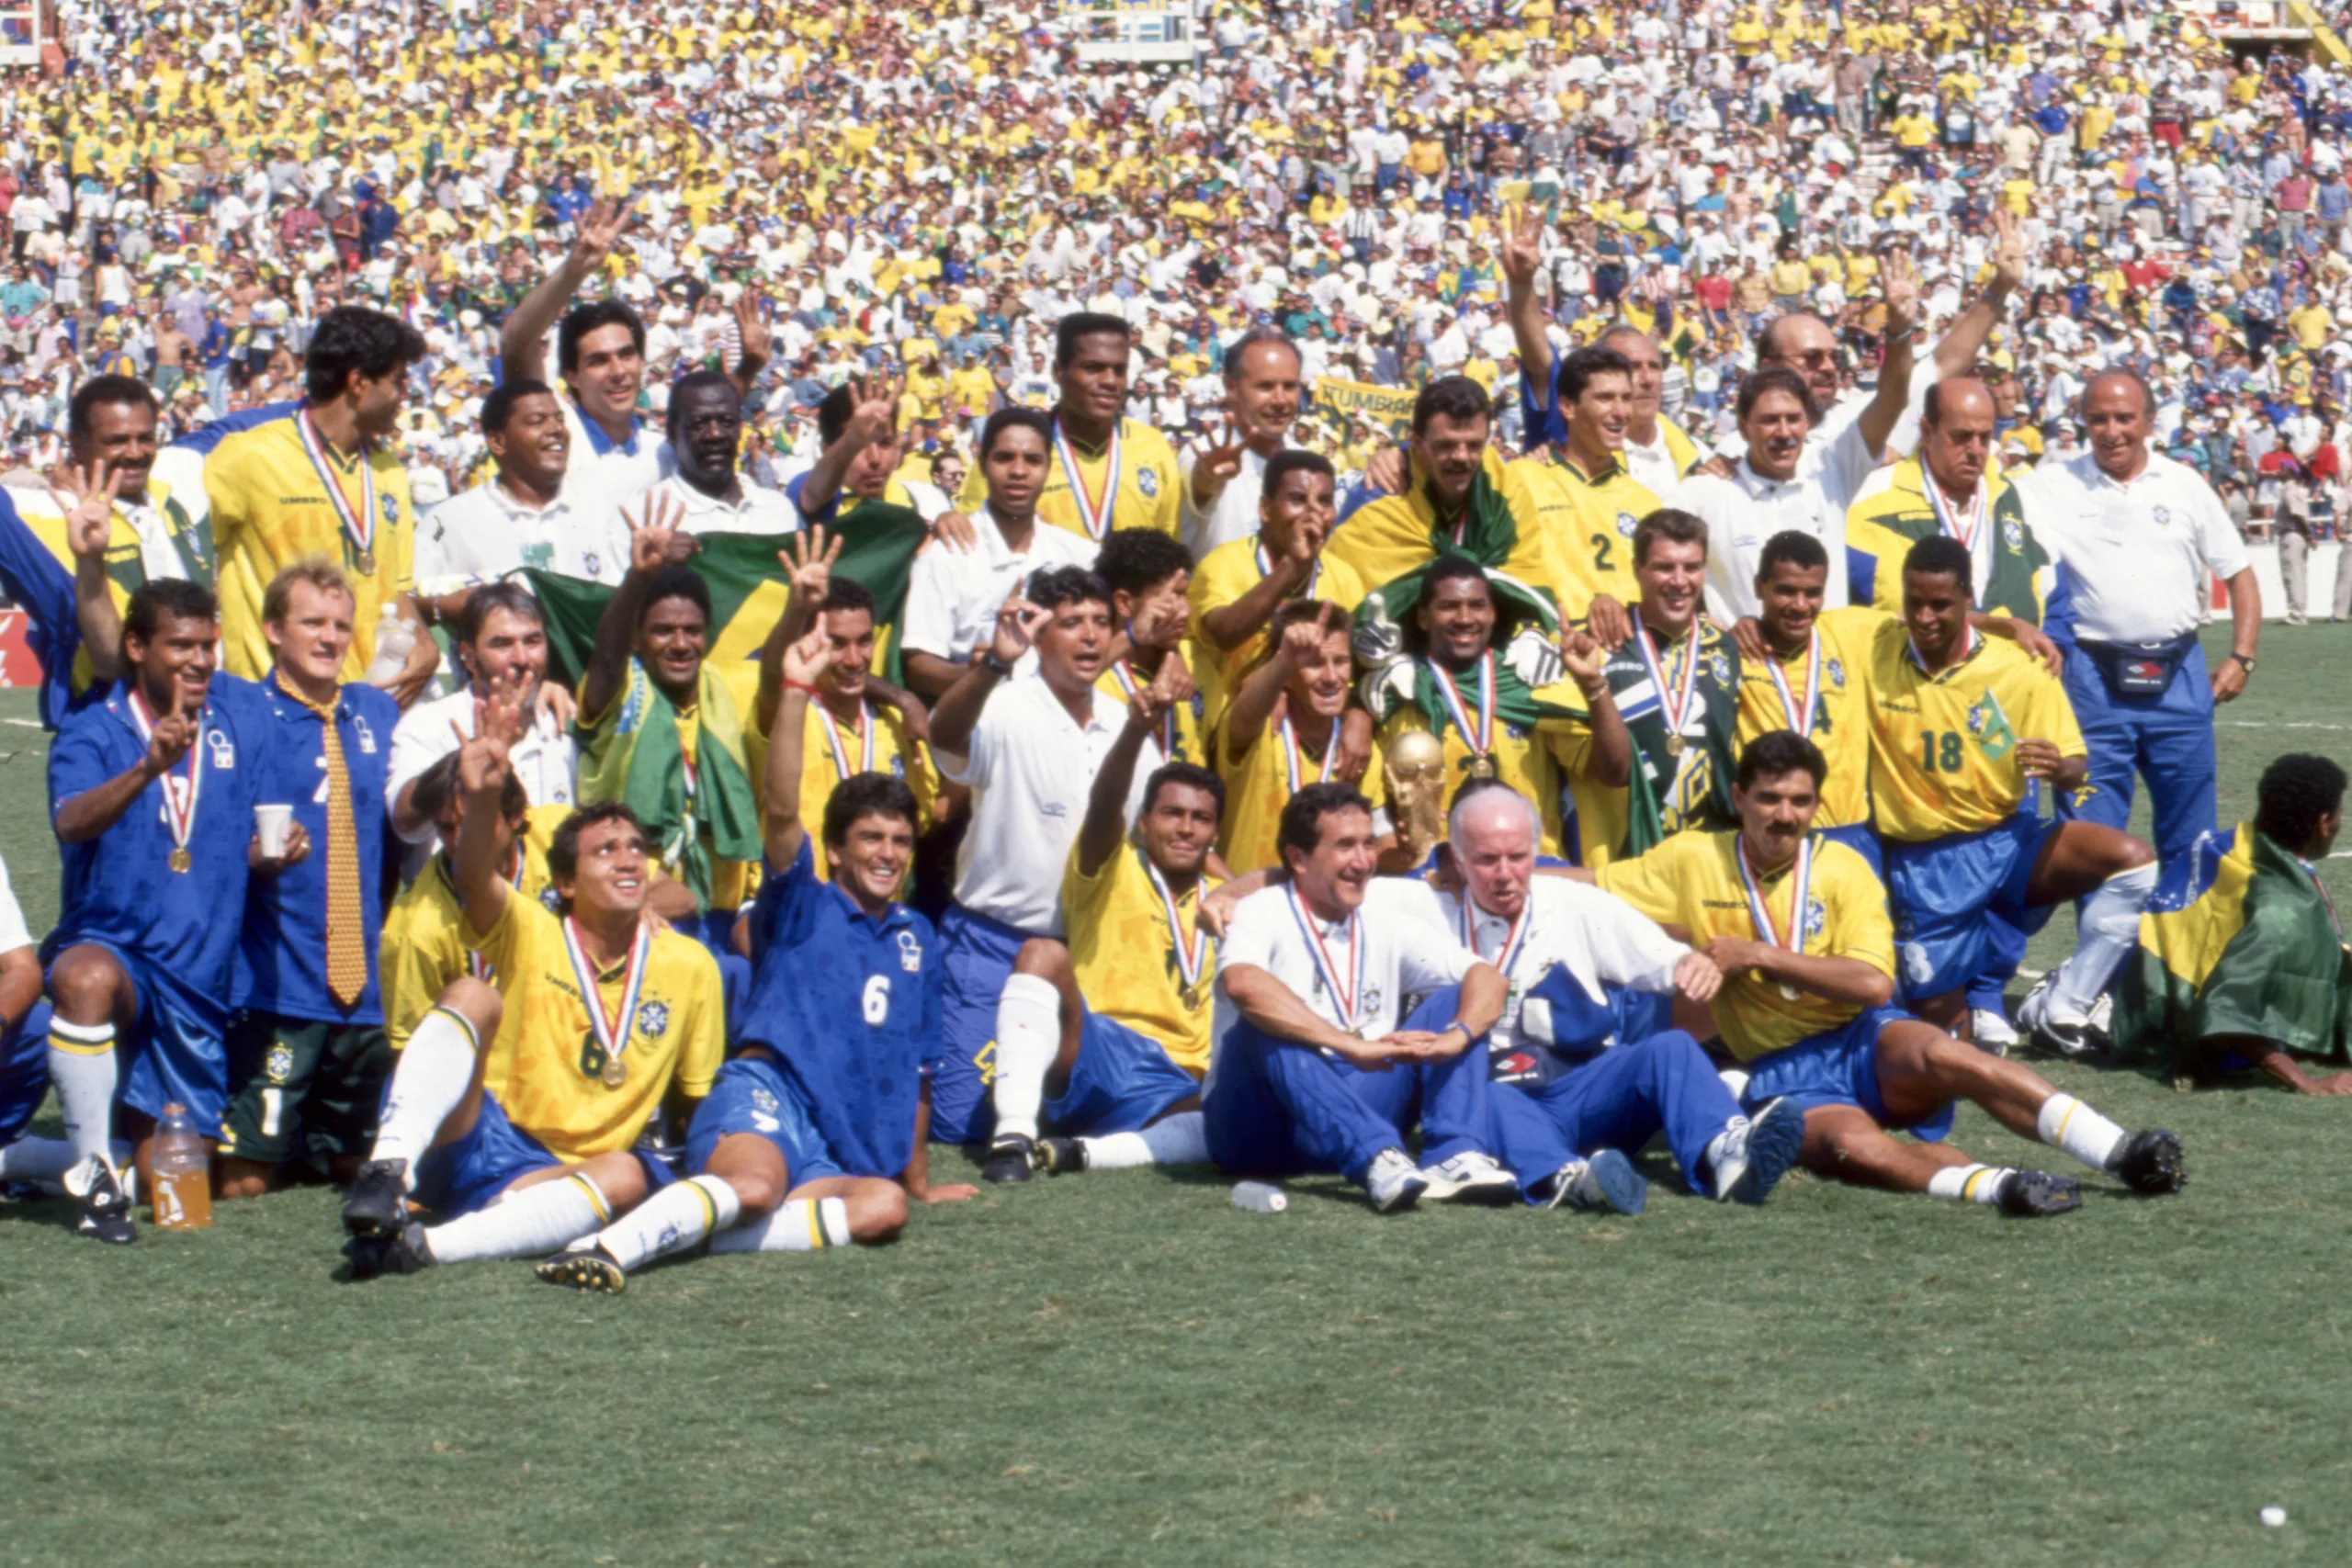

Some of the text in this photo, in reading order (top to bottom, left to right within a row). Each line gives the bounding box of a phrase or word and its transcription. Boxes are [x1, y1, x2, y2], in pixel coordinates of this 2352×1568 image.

[1590, 533, 1616, 571] 2
[1920, 730, 1963, 773] 18
[862, 974, 890, 1025] 6
[261, 1088, 282, 1136] 1
